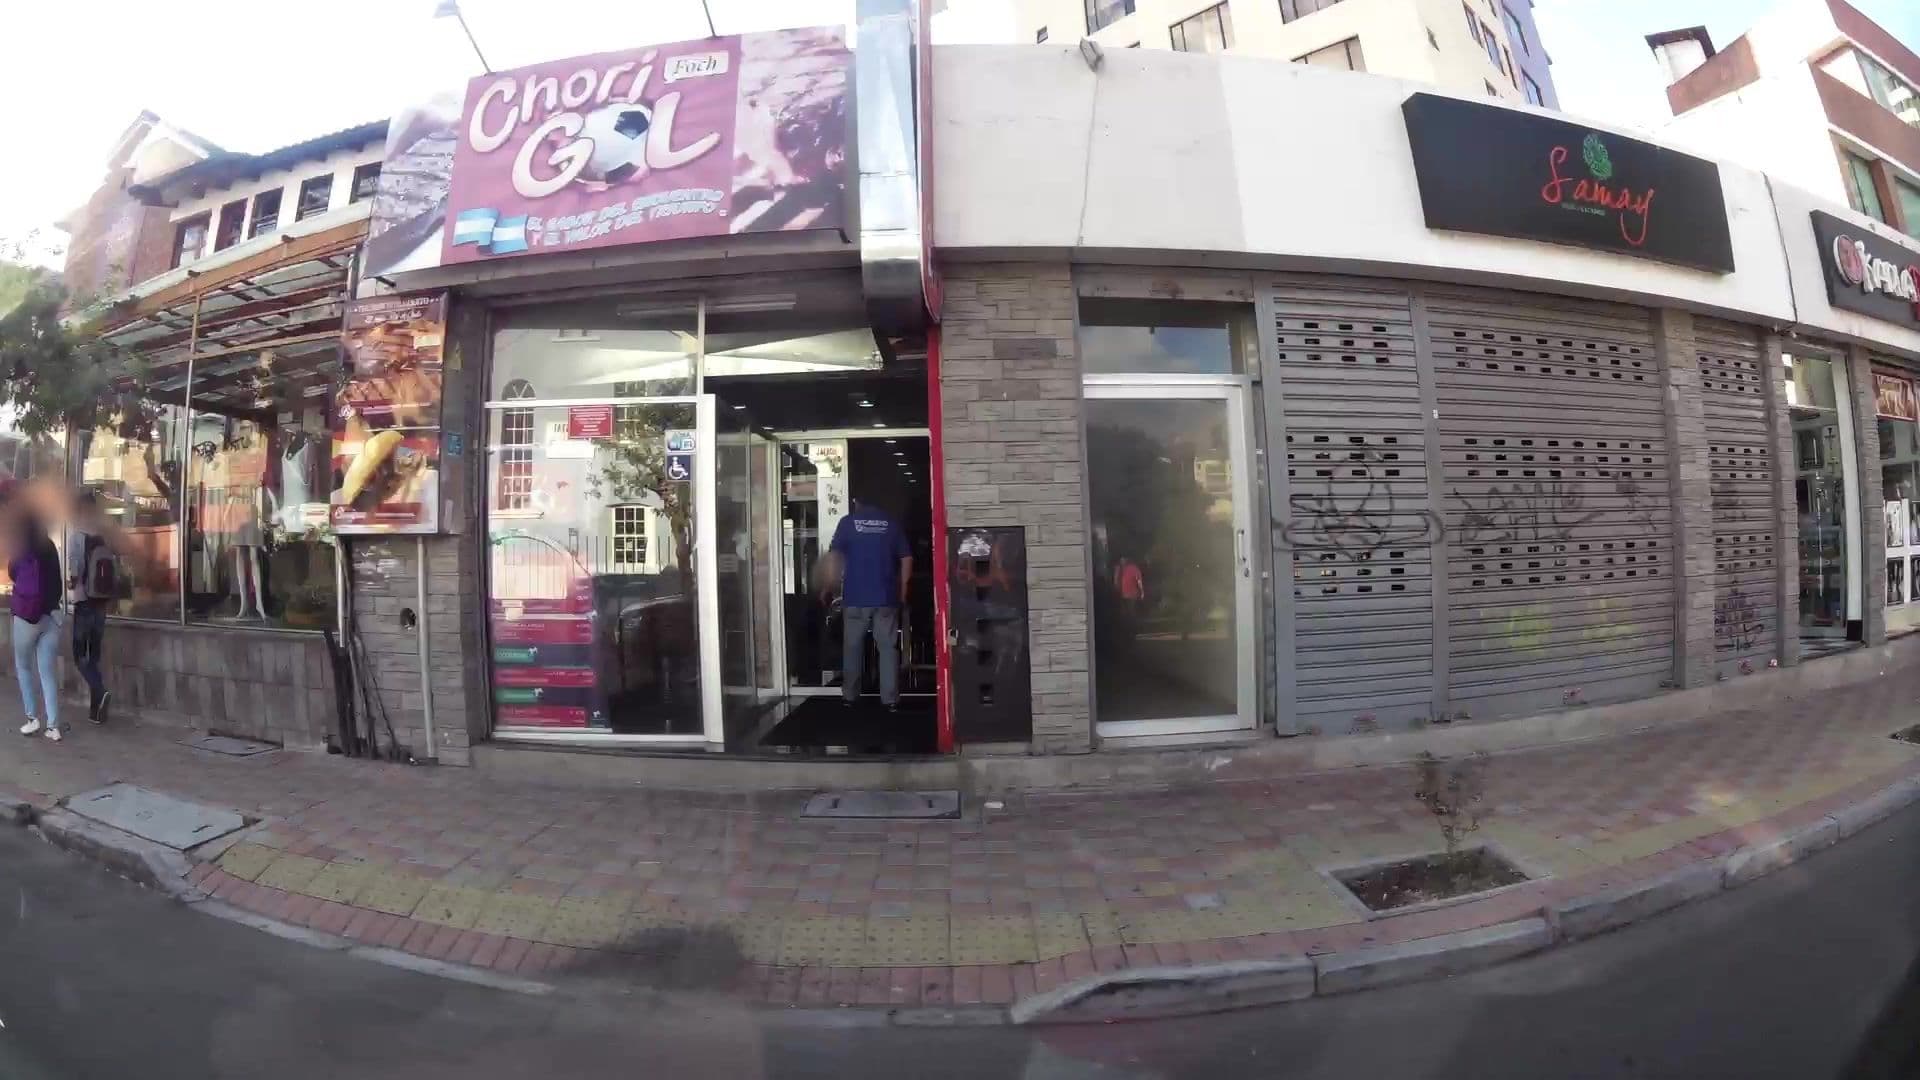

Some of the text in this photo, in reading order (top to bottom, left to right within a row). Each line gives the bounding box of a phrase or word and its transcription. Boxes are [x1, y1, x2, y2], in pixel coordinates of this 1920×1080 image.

[469, 50, 660, 153] Chori
[674, 55, 718, 75] Foch
[511, 91, 721, 198] GOL
[1542, 146, 1654, 245] Samay
